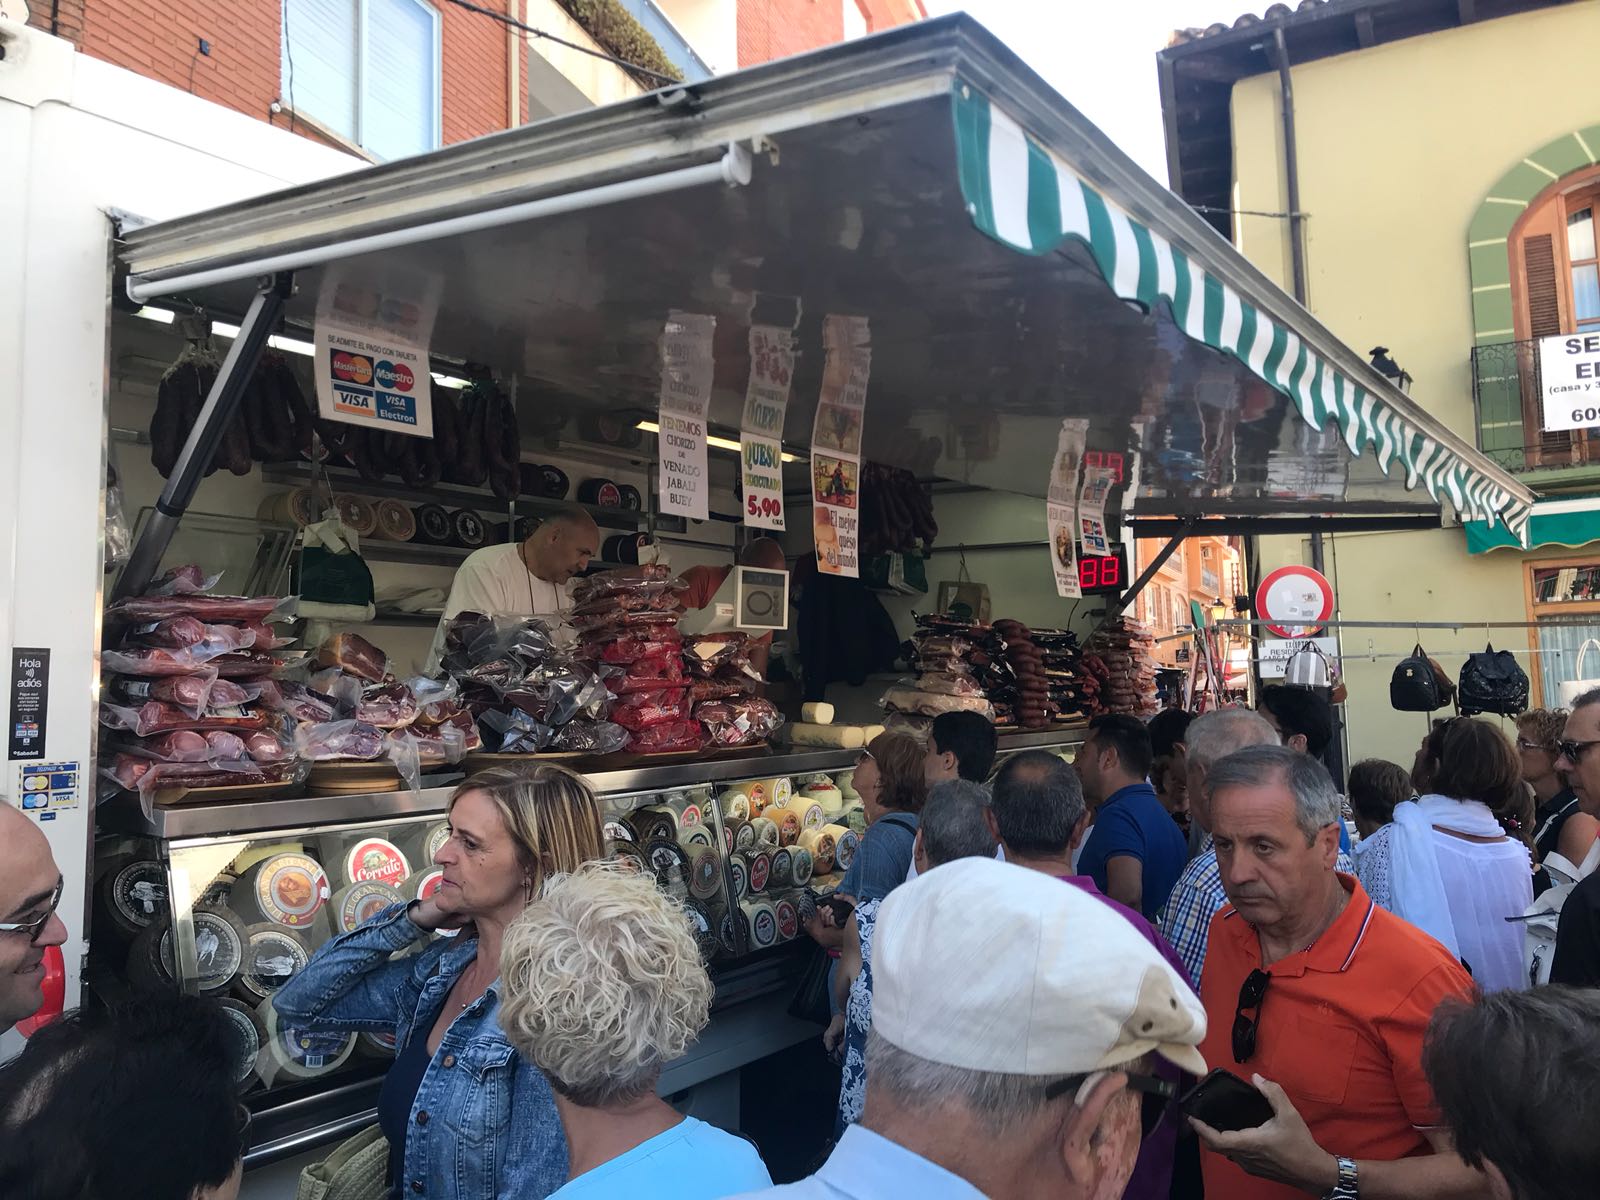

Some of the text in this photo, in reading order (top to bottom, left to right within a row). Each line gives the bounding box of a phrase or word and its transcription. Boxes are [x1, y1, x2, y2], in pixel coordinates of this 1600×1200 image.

[328, 335, 418, 362] SE ADMITE EL PAGO CON TARJETA
[1566, 336, 1600, 354] SE
[375, 368, 414, 385] Maestro
[1549, 384, 1581, 395] (casa
[1585, 383, 1591, 391] y
[340, 392, 369, 408] VISA
[385, 395, 406, 406] VISA
[380, 409, 415, 423] Electron
[1572, 408, 1600, 422] 60
[661, 415, 702, 437] TENEMOS
[666, 434, 696, 451] CHORIZO
[744, 441, 780, 470] QUESO
[663, 459, 701, 477] VENADO
[667, 477, 697, 492] JABALI
[669, 493, 693, 507] BUEY
[747, 494, 781, 518] 5,90
[830, 510, 857, 534] El mejor
[838, 535, 857, 553] queso
[826, 547, 857, 569] del mundo
[19, 658, 41, 668] Hola
[17, 678, 42, 687] adiós
[357, 857, 401, 882] Cerrato
[352, 884, 376, 904] GRAN
